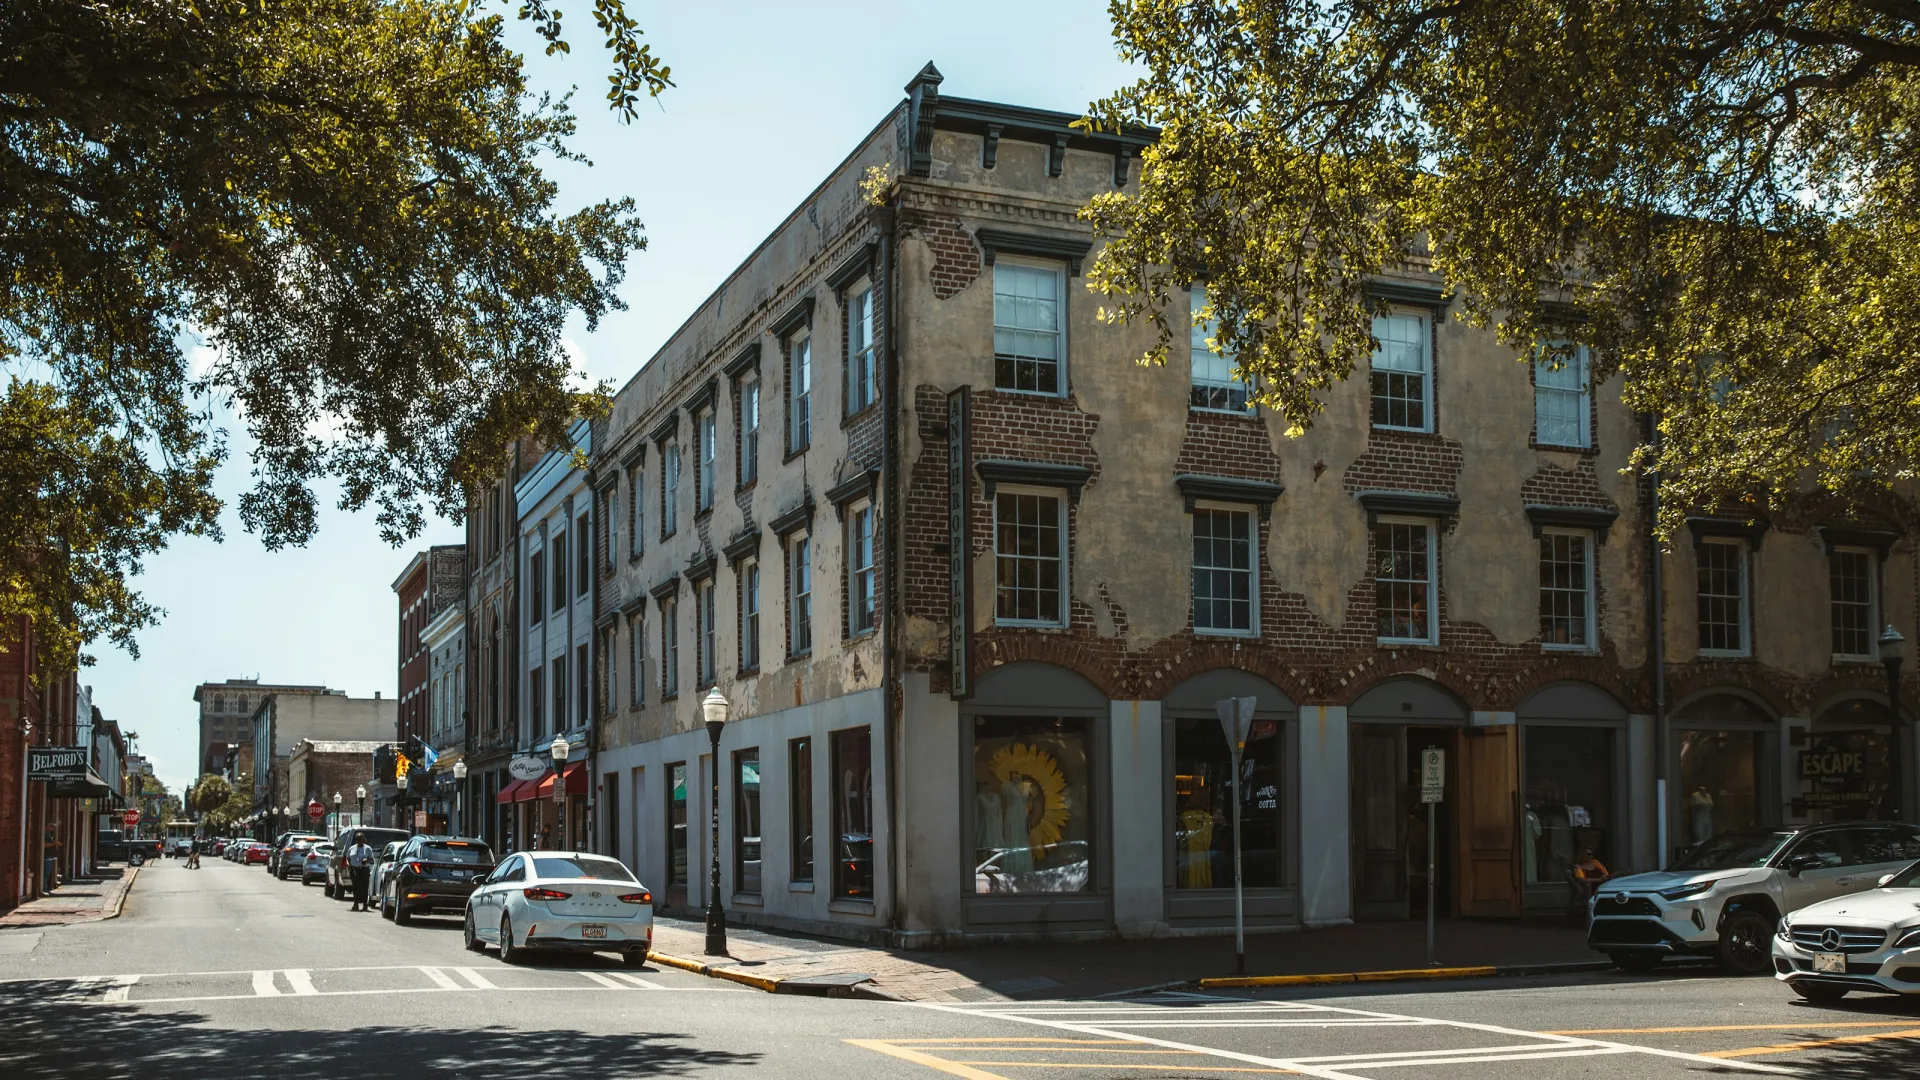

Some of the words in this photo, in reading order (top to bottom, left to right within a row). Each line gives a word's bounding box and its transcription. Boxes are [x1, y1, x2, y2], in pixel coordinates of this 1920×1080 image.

[951, 399, 962, 690] ANTHROPOLOGIE
[32, 752, 84, 772] BELFORD'S
[1802, 752, 1863, 775] ESCAPE
[309, 806, 324, 814] STOP
